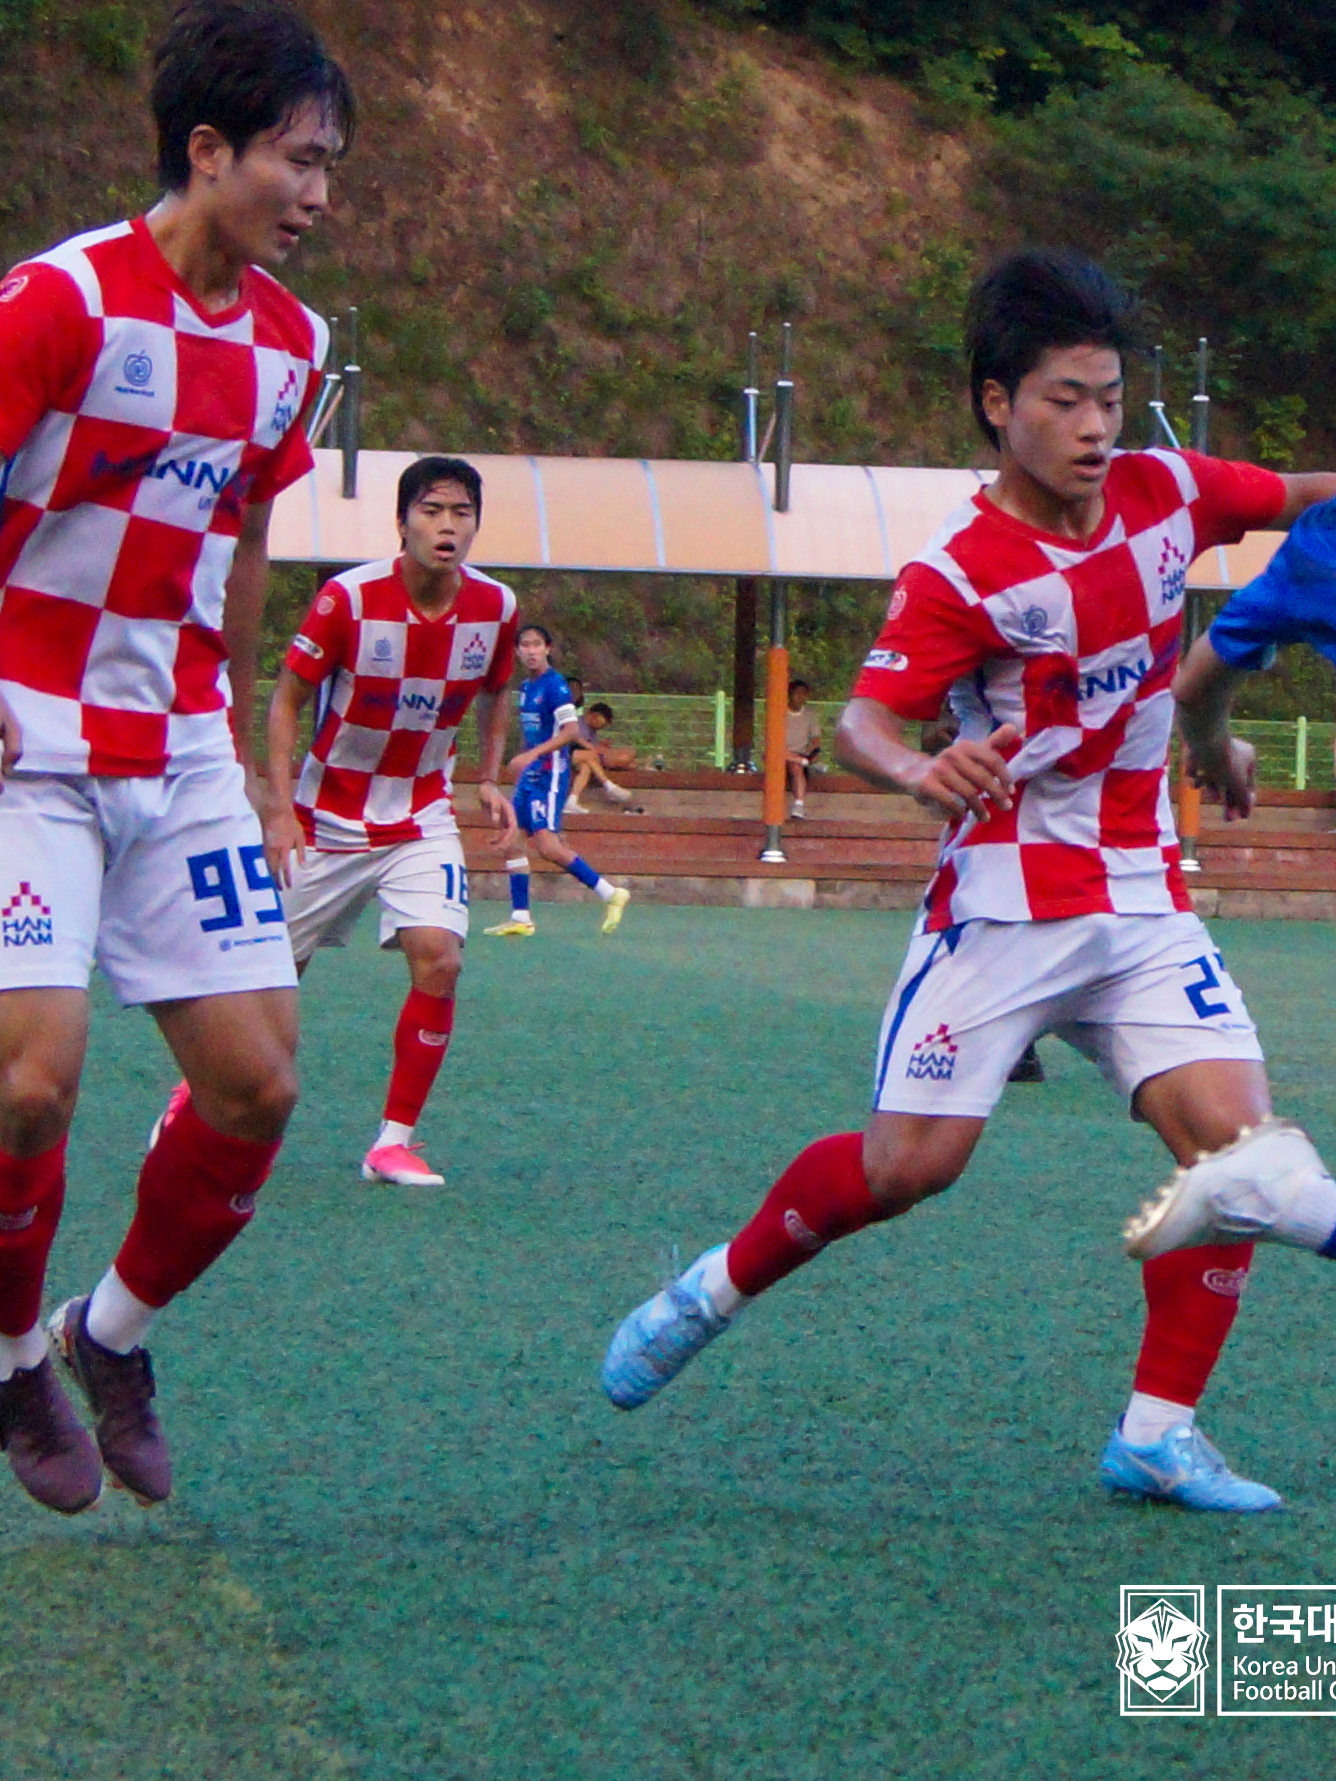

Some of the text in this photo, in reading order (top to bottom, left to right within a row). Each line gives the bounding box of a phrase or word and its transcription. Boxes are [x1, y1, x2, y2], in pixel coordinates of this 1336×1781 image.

[2, 915, 51, 933] HAN
[4, 930, 53, 948] NAM
[1180, 951, 1231, 1020] 2
[909, 1051, 956, 1067] HAN
[905, 1065, 952, 1080] NAM
